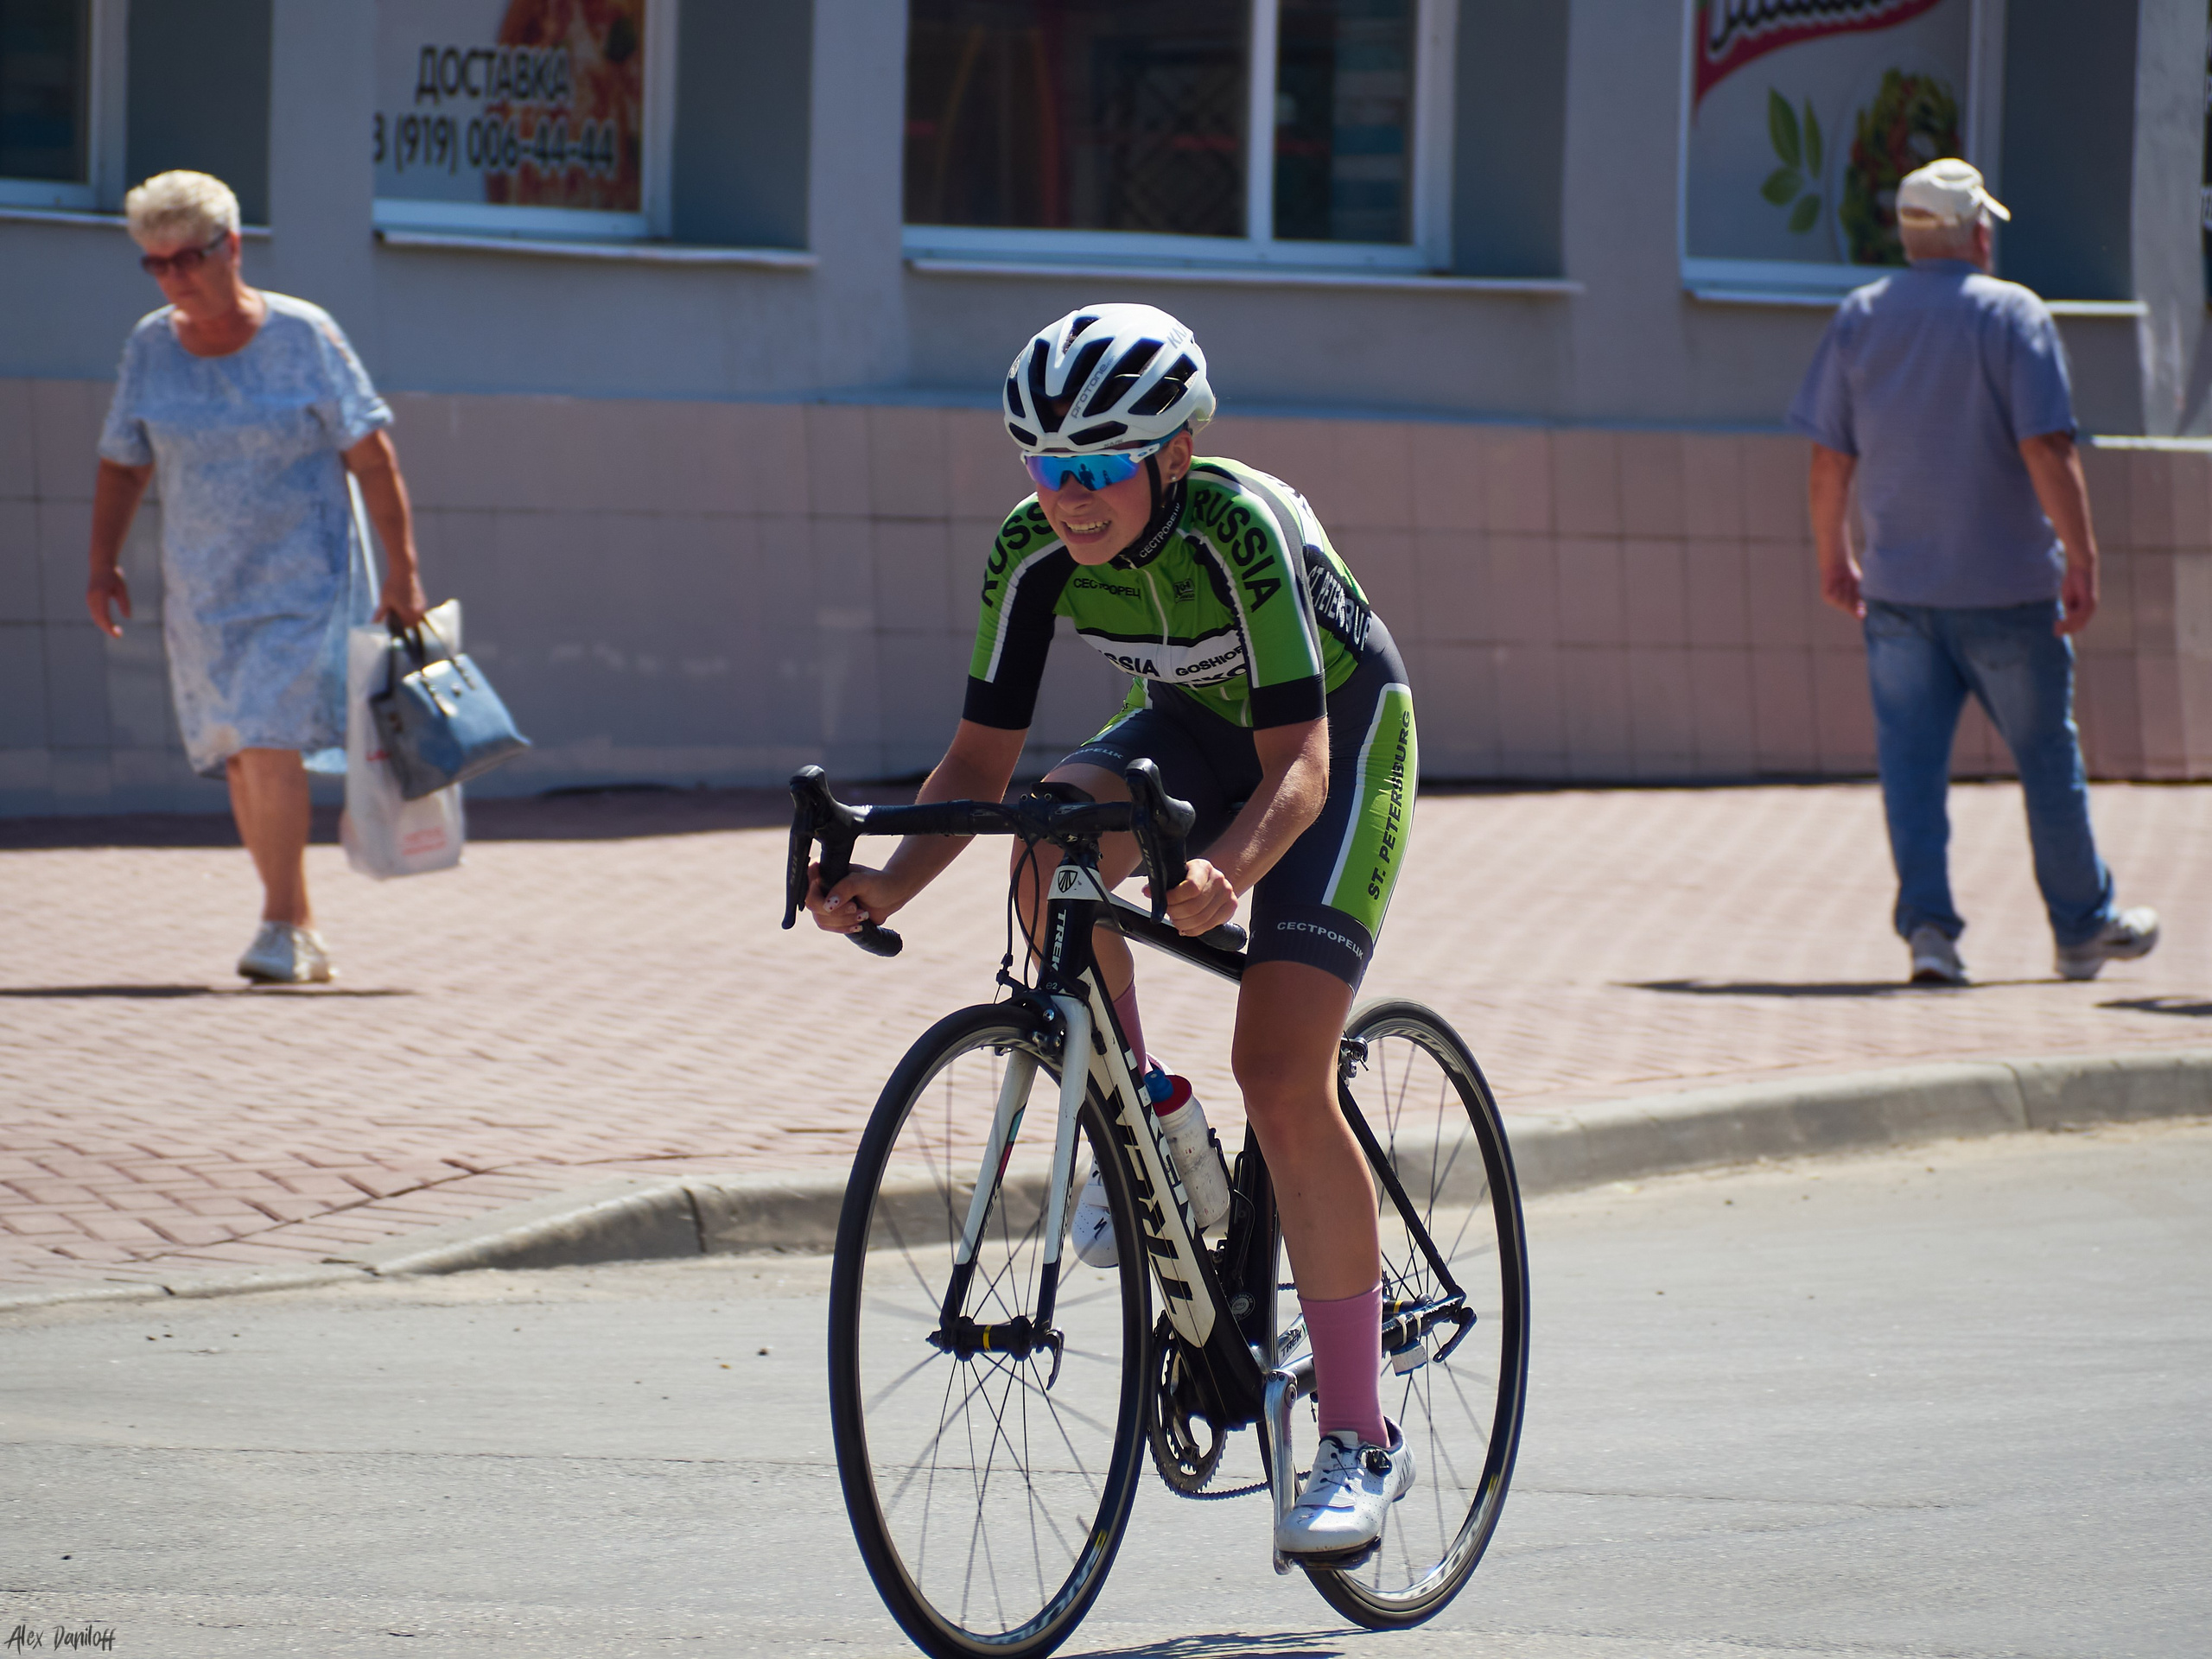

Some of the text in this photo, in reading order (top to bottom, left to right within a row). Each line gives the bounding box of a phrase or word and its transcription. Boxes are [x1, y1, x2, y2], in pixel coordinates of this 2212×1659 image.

[415, 46, 571, 106] ДОСТАВКА
[396, 115, 456, 175] (919)
[467, 116, 614, 172] 006-44-44
[1191, 489, 1281, 613] RUSSIA
[1379, 710, 1410, 857] PETERSBURG
[1052, 909, 1066, 972] TREK
[1277, 921, 1363, 961] СЕСТРОРЕЦК
